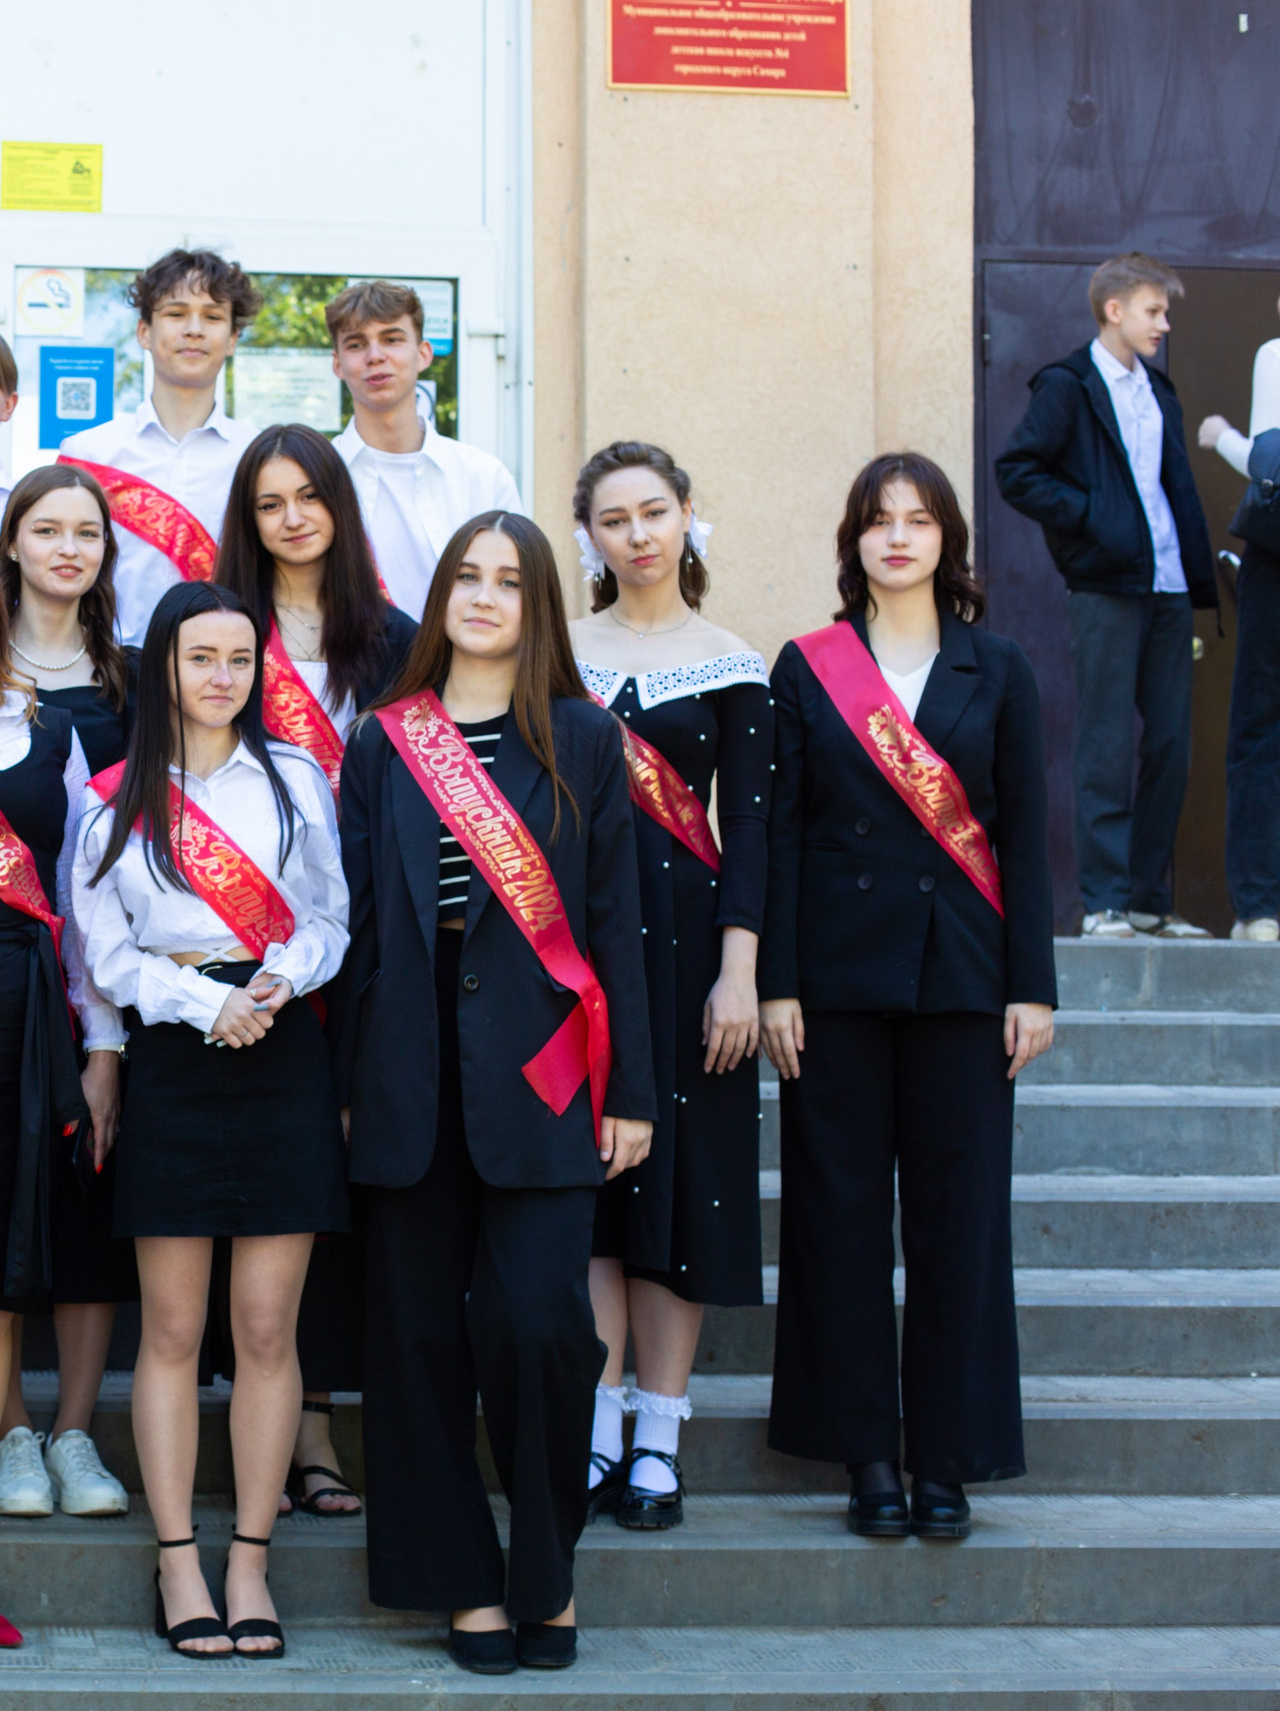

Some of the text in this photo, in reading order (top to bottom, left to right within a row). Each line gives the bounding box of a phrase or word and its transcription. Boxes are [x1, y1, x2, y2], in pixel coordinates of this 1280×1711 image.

[270, 680, 341, 790] Выпус
[417, 734, 564, 935] Выпускник 2024
[188, 841, 288, 943] Выпуск
